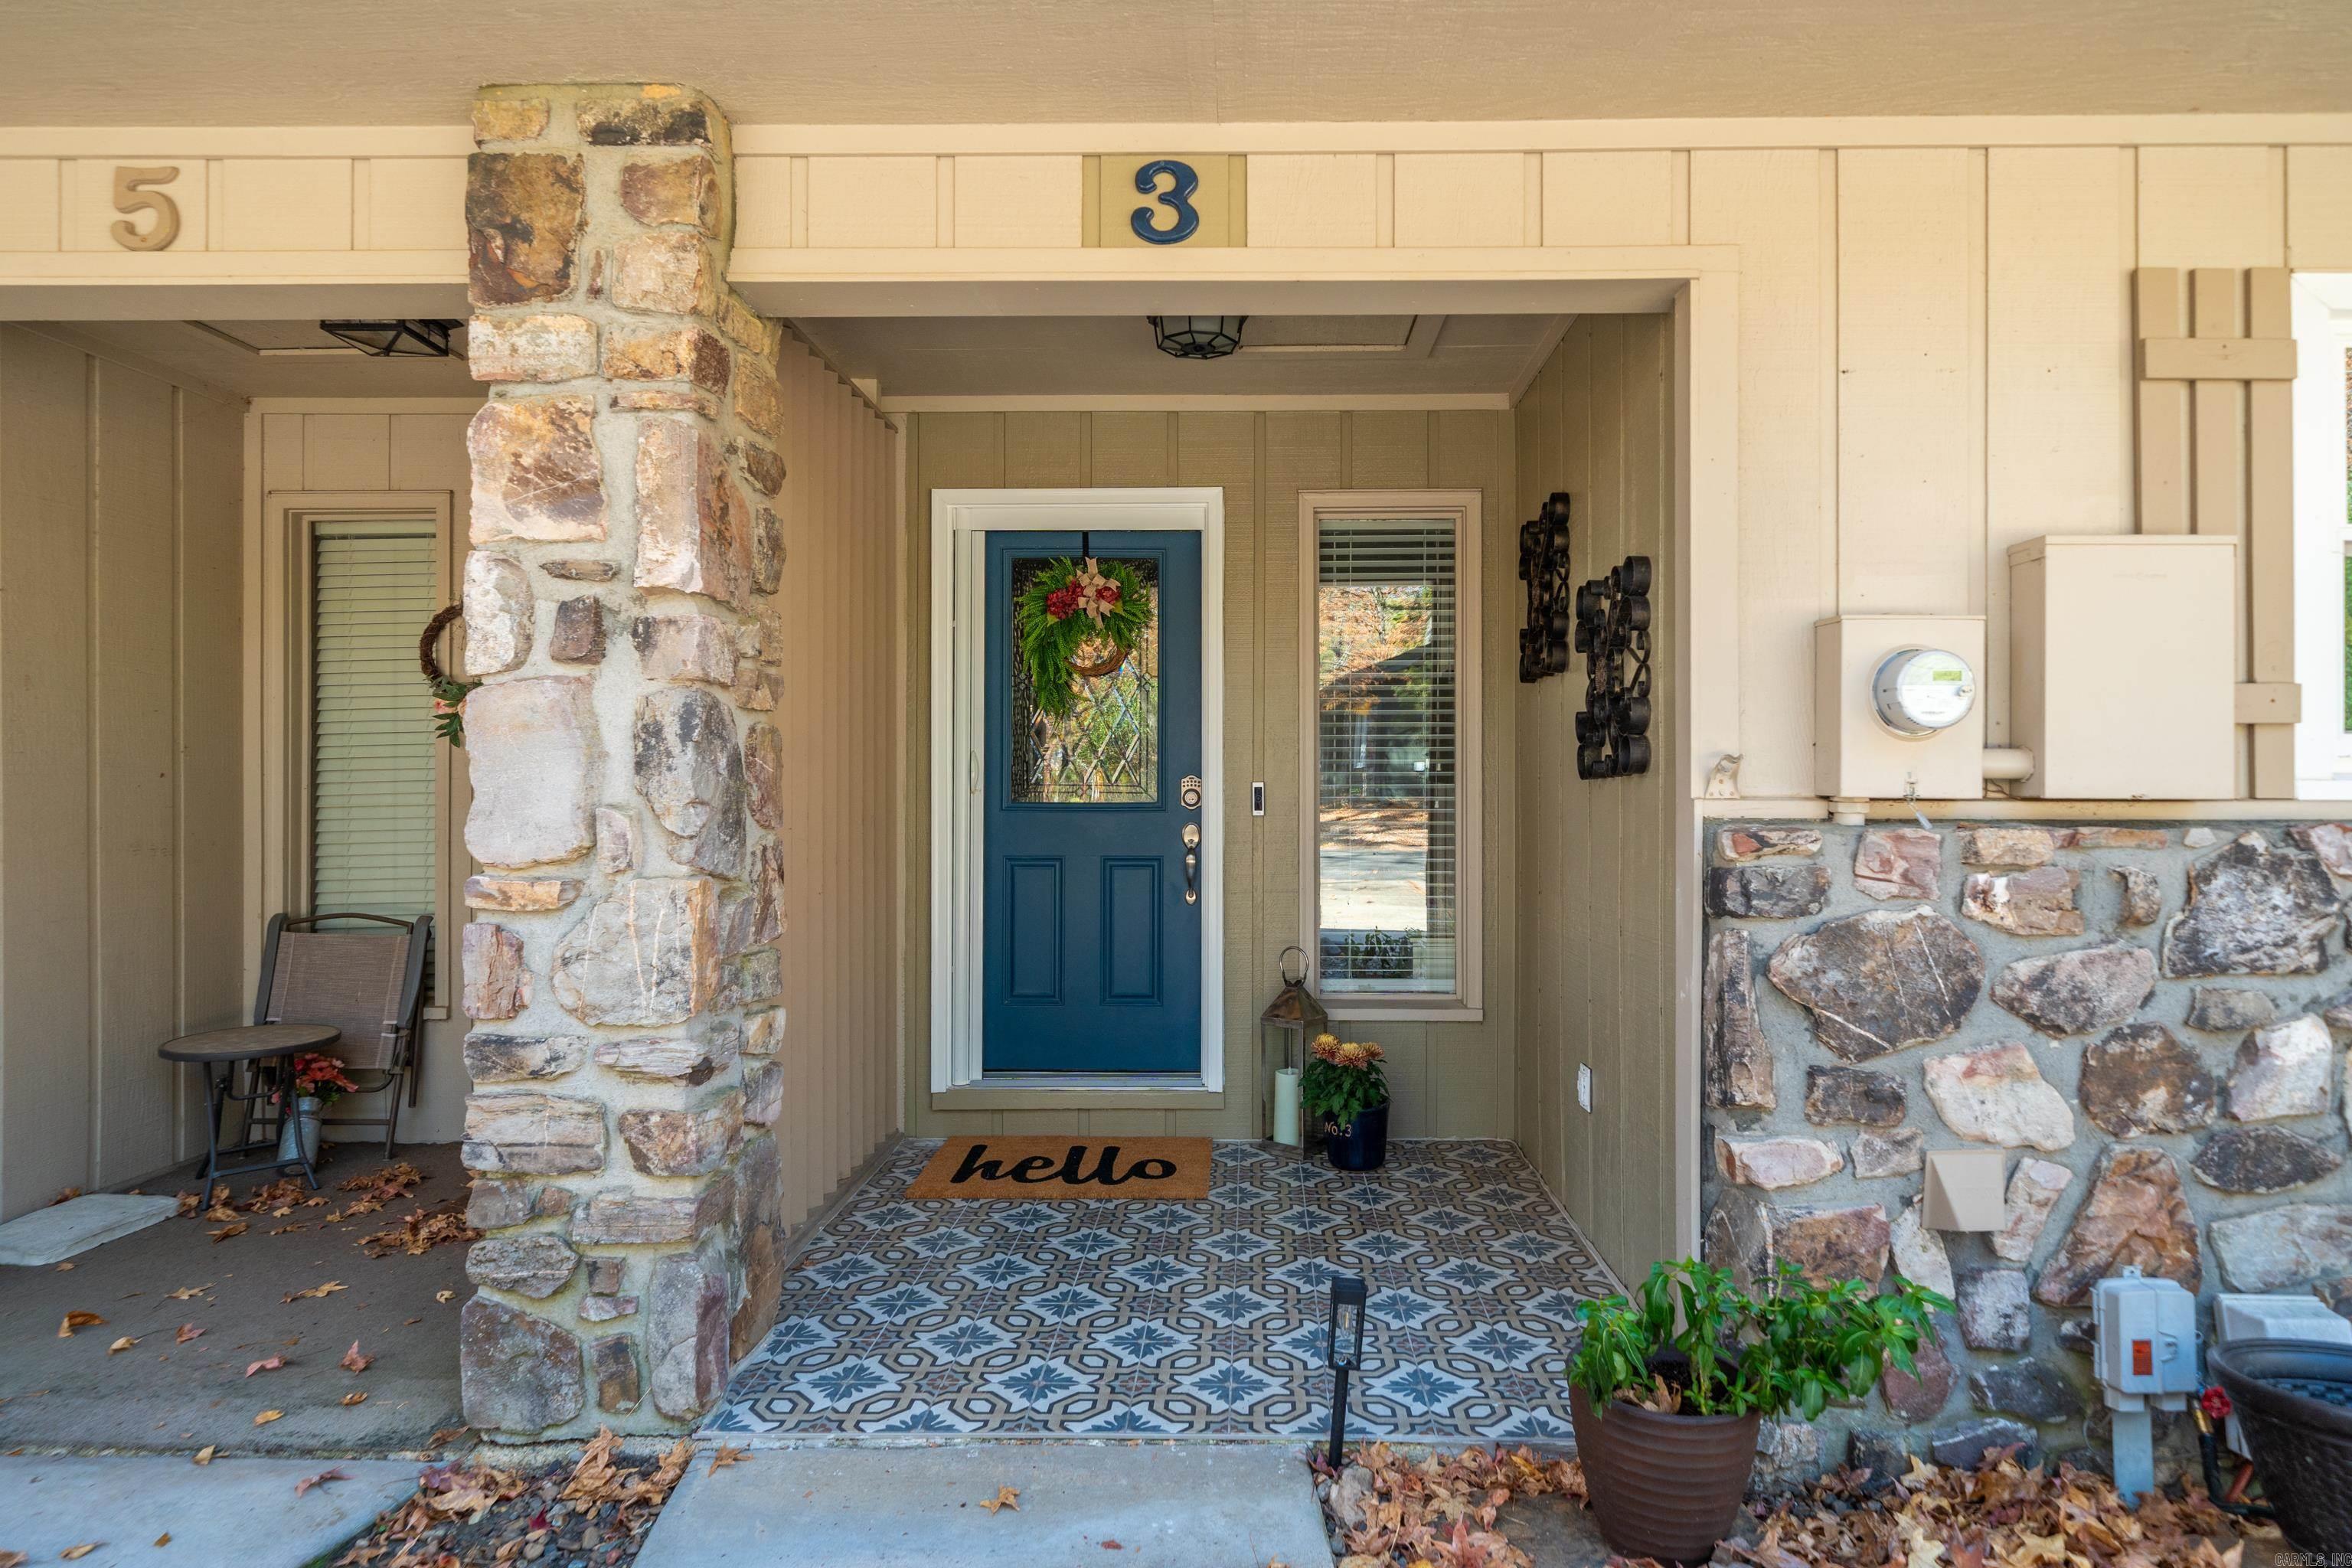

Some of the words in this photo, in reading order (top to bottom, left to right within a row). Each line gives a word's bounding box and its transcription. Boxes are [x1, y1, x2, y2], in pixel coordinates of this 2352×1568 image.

[109, 165, 181, 252] 5
[1131, 159, 1200, 245] 3
[949, 1144, 1178, 1186] hello
